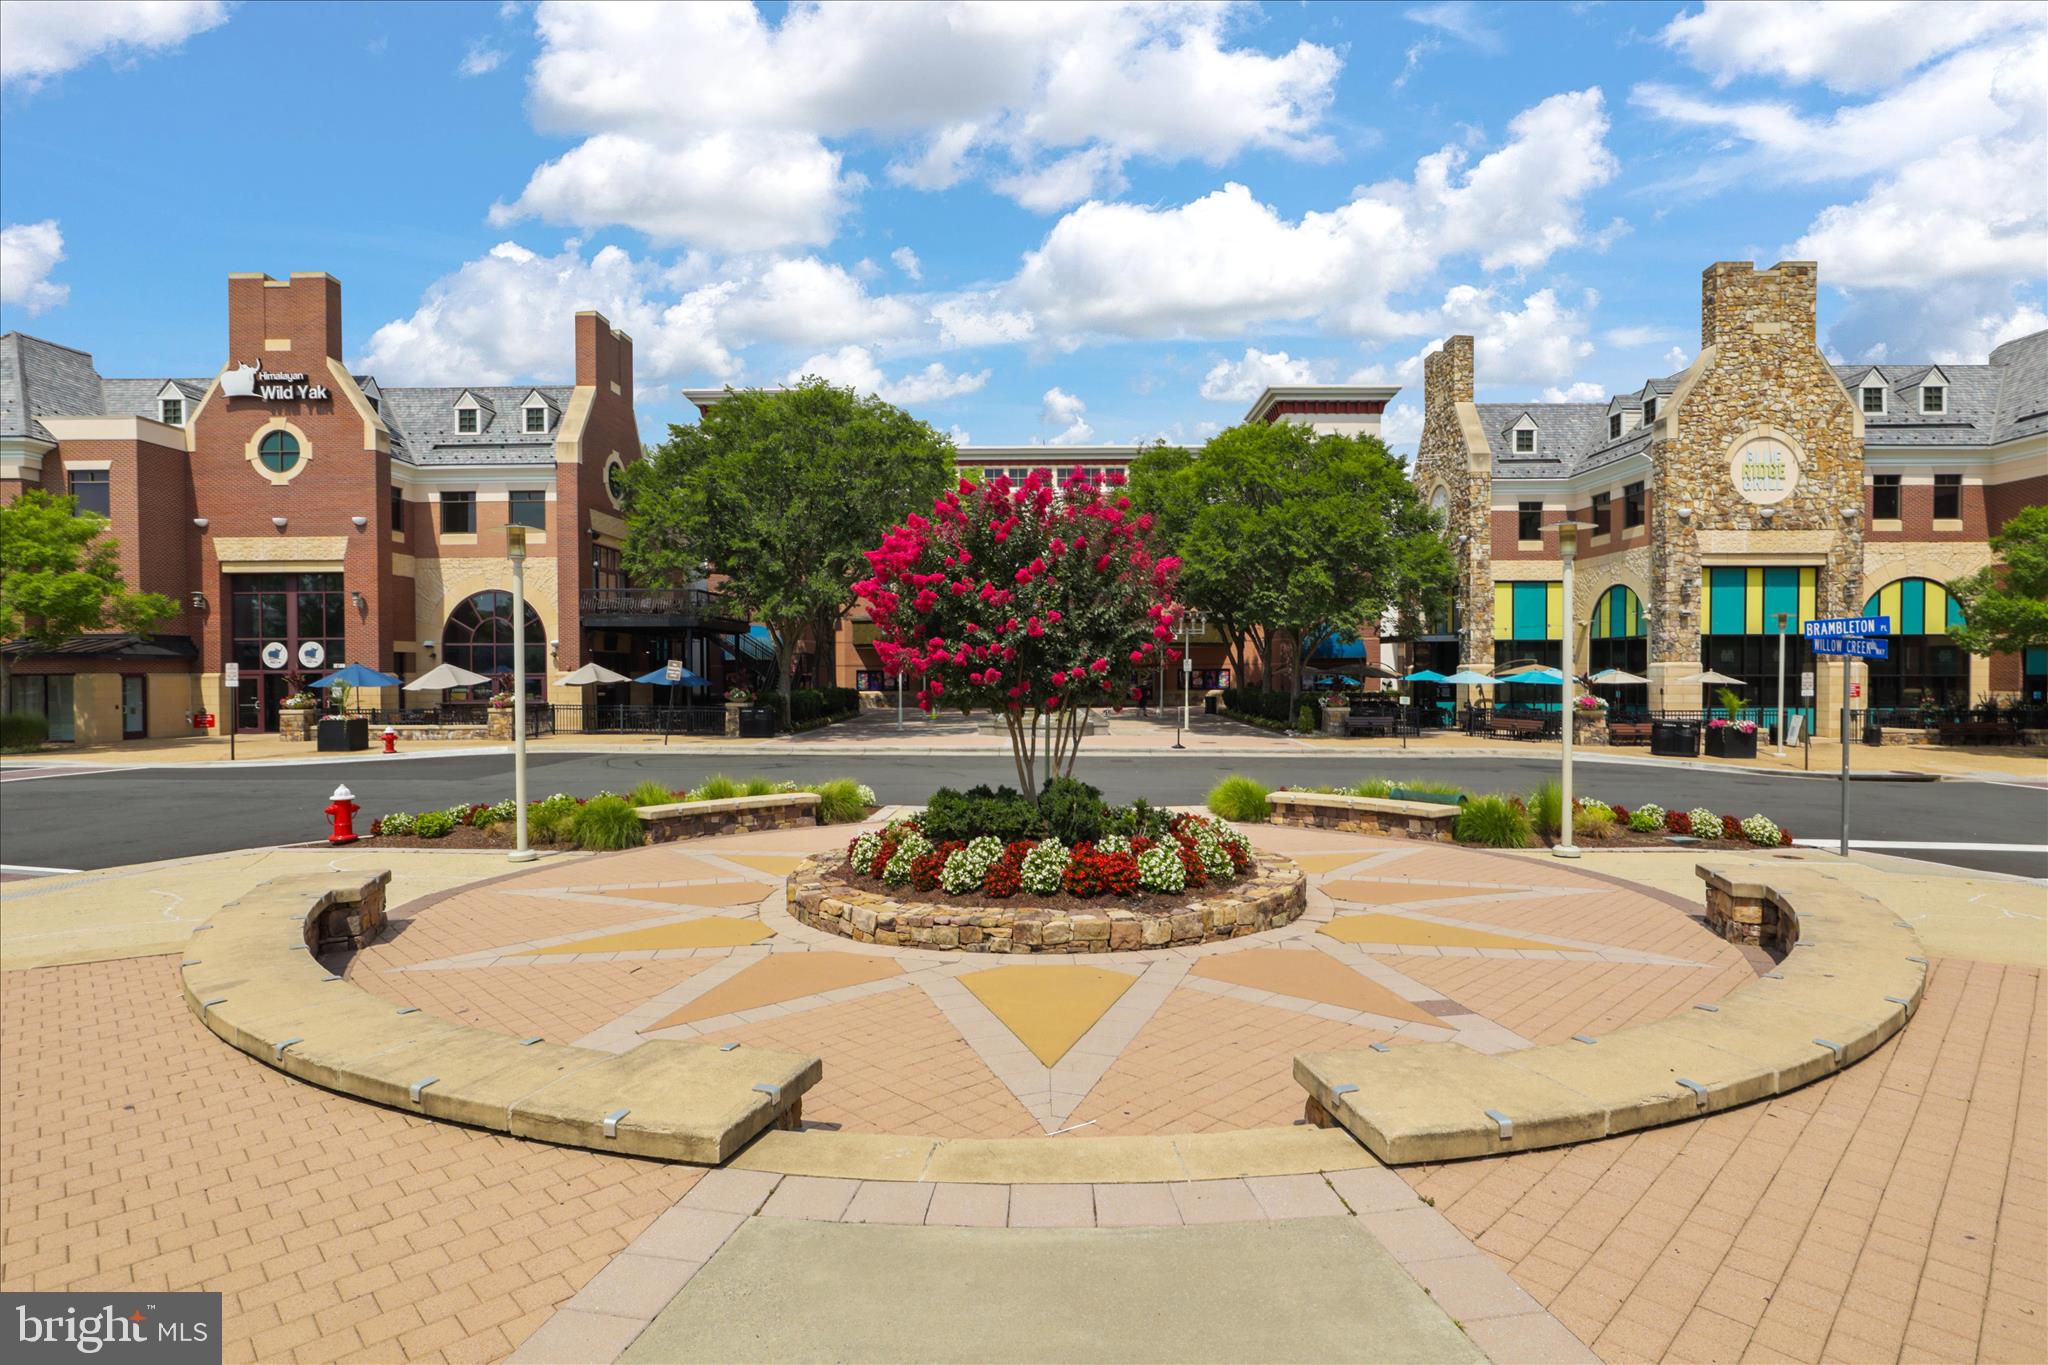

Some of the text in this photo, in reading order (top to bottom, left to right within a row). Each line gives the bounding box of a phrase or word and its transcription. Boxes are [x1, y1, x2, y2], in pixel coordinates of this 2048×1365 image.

[259, 372, 304, 382] Himalayan
[260, 385, 328, 400] Wild Yak
[1742, 463, 1786, 480] RIDGE
[1743, 478, 1784, 492] GRILL
[1806, 619, 1889, 637] BRAMBLETON PL
[1814, 638, 1842, 652] WILLOW
[1846, 641, 1872, 654] CREEK
